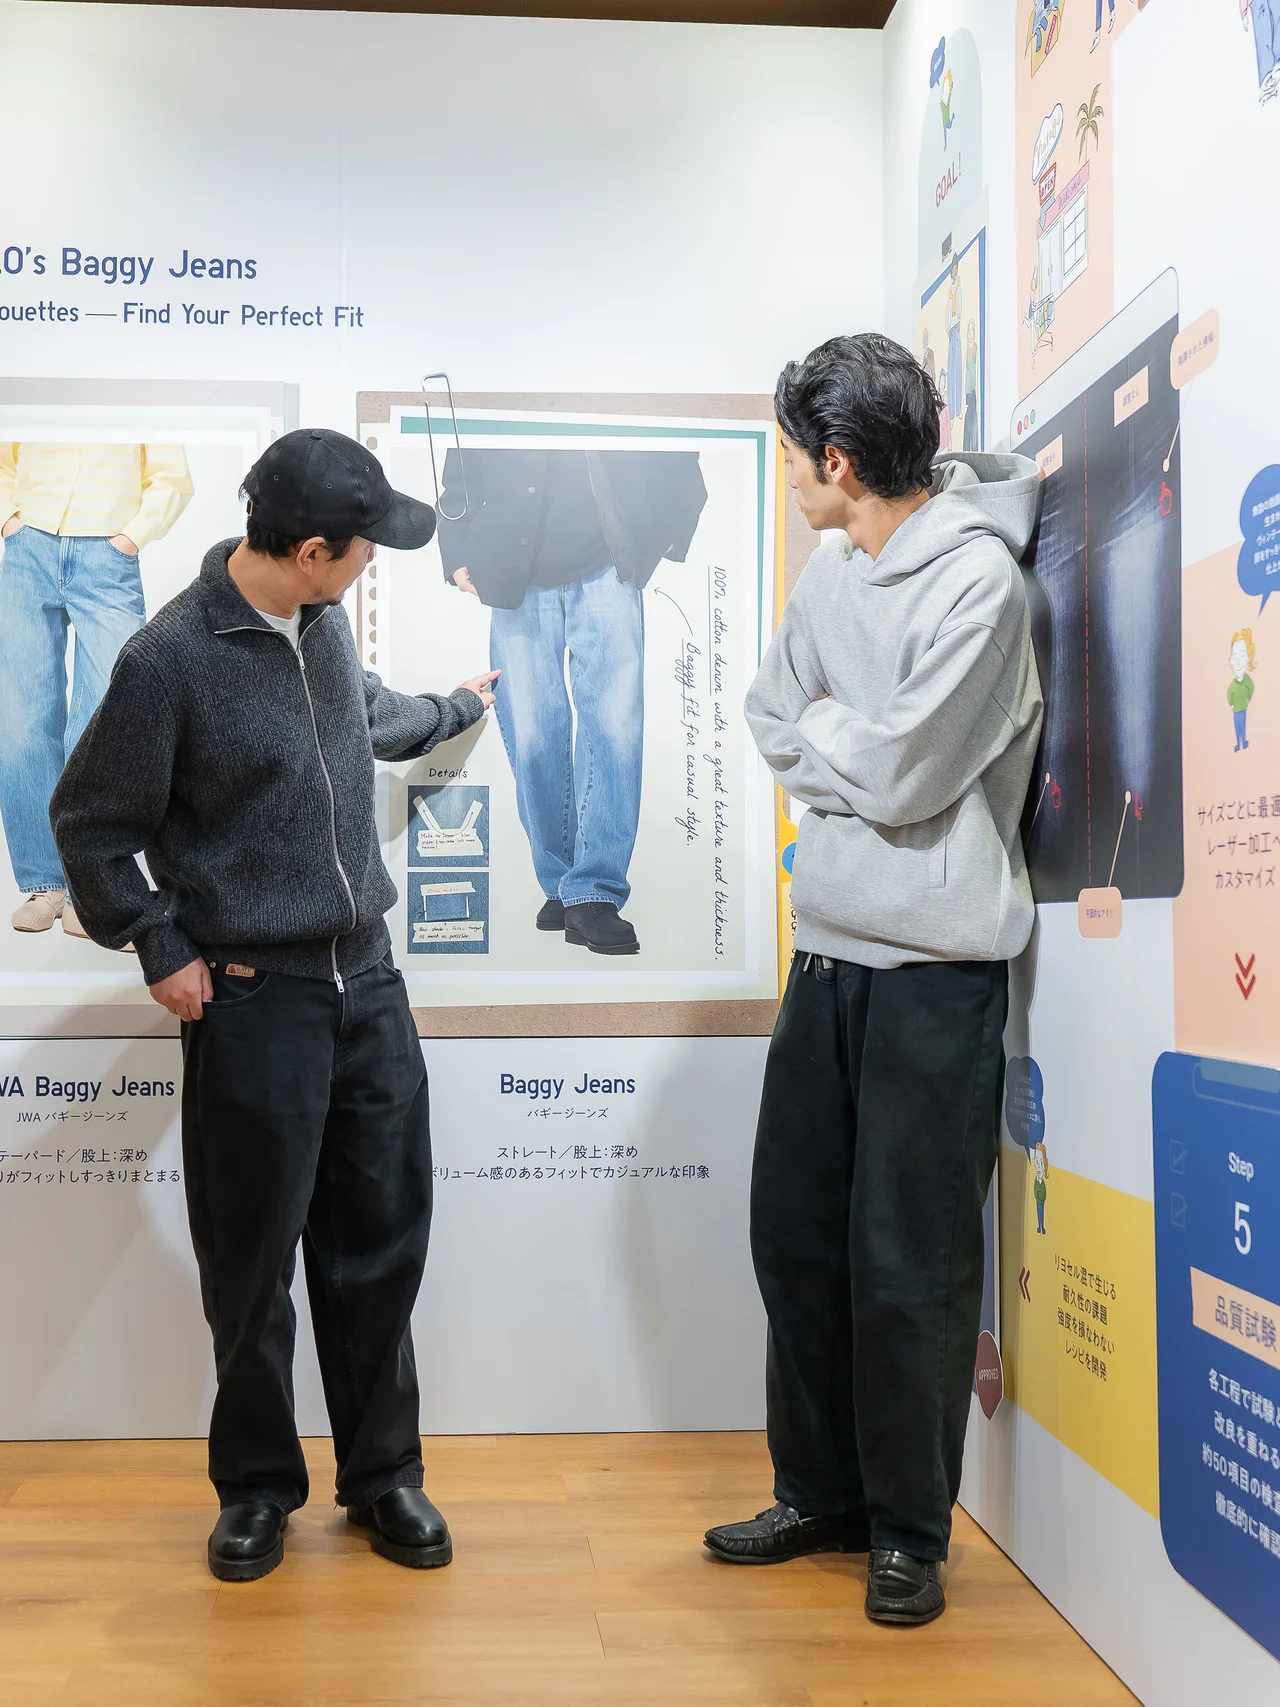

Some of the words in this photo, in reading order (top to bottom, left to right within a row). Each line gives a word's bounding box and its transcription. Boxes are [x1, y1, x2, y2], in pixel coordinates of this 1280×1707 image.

[935, 152, 962, 207] GOAL!
[61, 247, 154, 285] Baggy
[168, 249, 258, 280] Jeans
[123, 302, 171, 324] Find
[182, 303, 230, 325] Your
[241, 304, 323, 327] Perfect
[334, 306, 364, 328] Fit
[713, 608, 727, 645] cotton
[674, 643, 702, 688] Baggy
[713, 653, 728, 695] denim
[680, 696, 701, 717] fit
[713, 702, 728, 733] with
[680, 718, 701, 747] for
[713, 741, 722, 749] a
[428, 768, 468, 778] Details
[685, 753, 699, 798] casual
[703, 753, 728, 793] great
[674, 807, 700, 847] style.
[713, 800, 729, 848] texture
[713, 857, 729, 883] and
[1215, 865, 1275, 890] カスタマイズ
[713, 890, 729, 961] thickness.
[36, 1076, 102, 1102] Baggy
[112, 1076, 175, 1097] Jeans
[500, 1074, 564, 1099] Baggy
[574, 1074, 636, 1094] Jeans
[17, 1113, 41, 1122] JWA
[45, 1111, 128, 1122] バギージーンズ
[527, 1108, 608, 1119] バギージーンズ
[1228, 1152, 1254, 1182] Step
[1234, 1201, 1252, 1256] 5
[1062, 1283, 1108, 1326] 耐久性の課題
[1214, 1294, 1278, 1352] 品質試験
[1057, 1307, 1115, 1355] 強度を損なわない
[978, 1368, 999, 1381] APPROVED
[1065, 1340, 1107, 1382] レシピを開発
